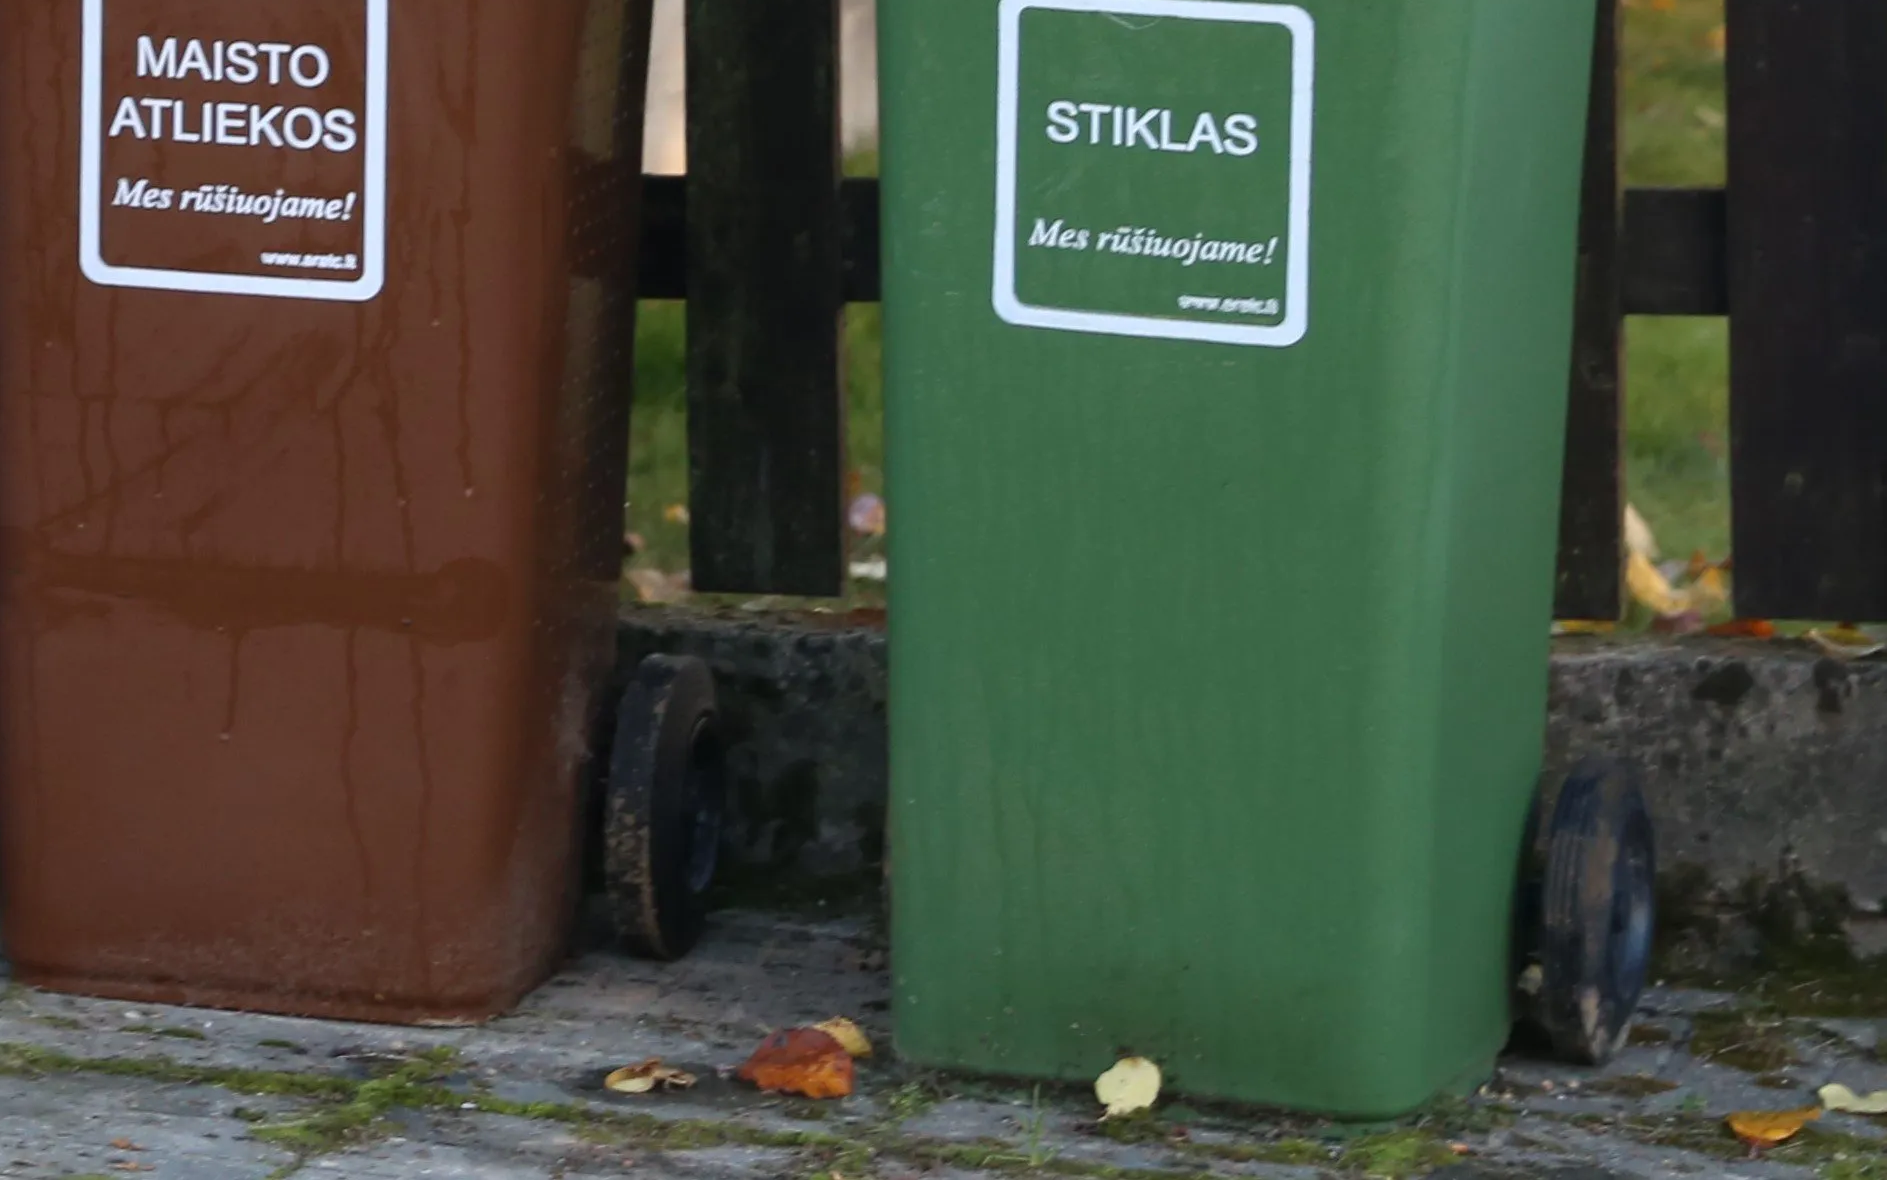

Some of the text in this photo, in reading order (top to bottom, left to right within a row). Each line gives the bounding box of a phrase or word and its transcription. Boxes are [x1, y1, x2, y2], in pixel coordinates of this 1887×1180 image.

[138, 36, 328, 86] MAISTO
[109, 97, 356, 151] ATLIEKOS
[1047, 101, 1257, 155] STIKLAS
[112, 179, 356, 223] Mes rūšiuojame!
[1029, 219, 1277, 265] Mes rūšiuojame!
